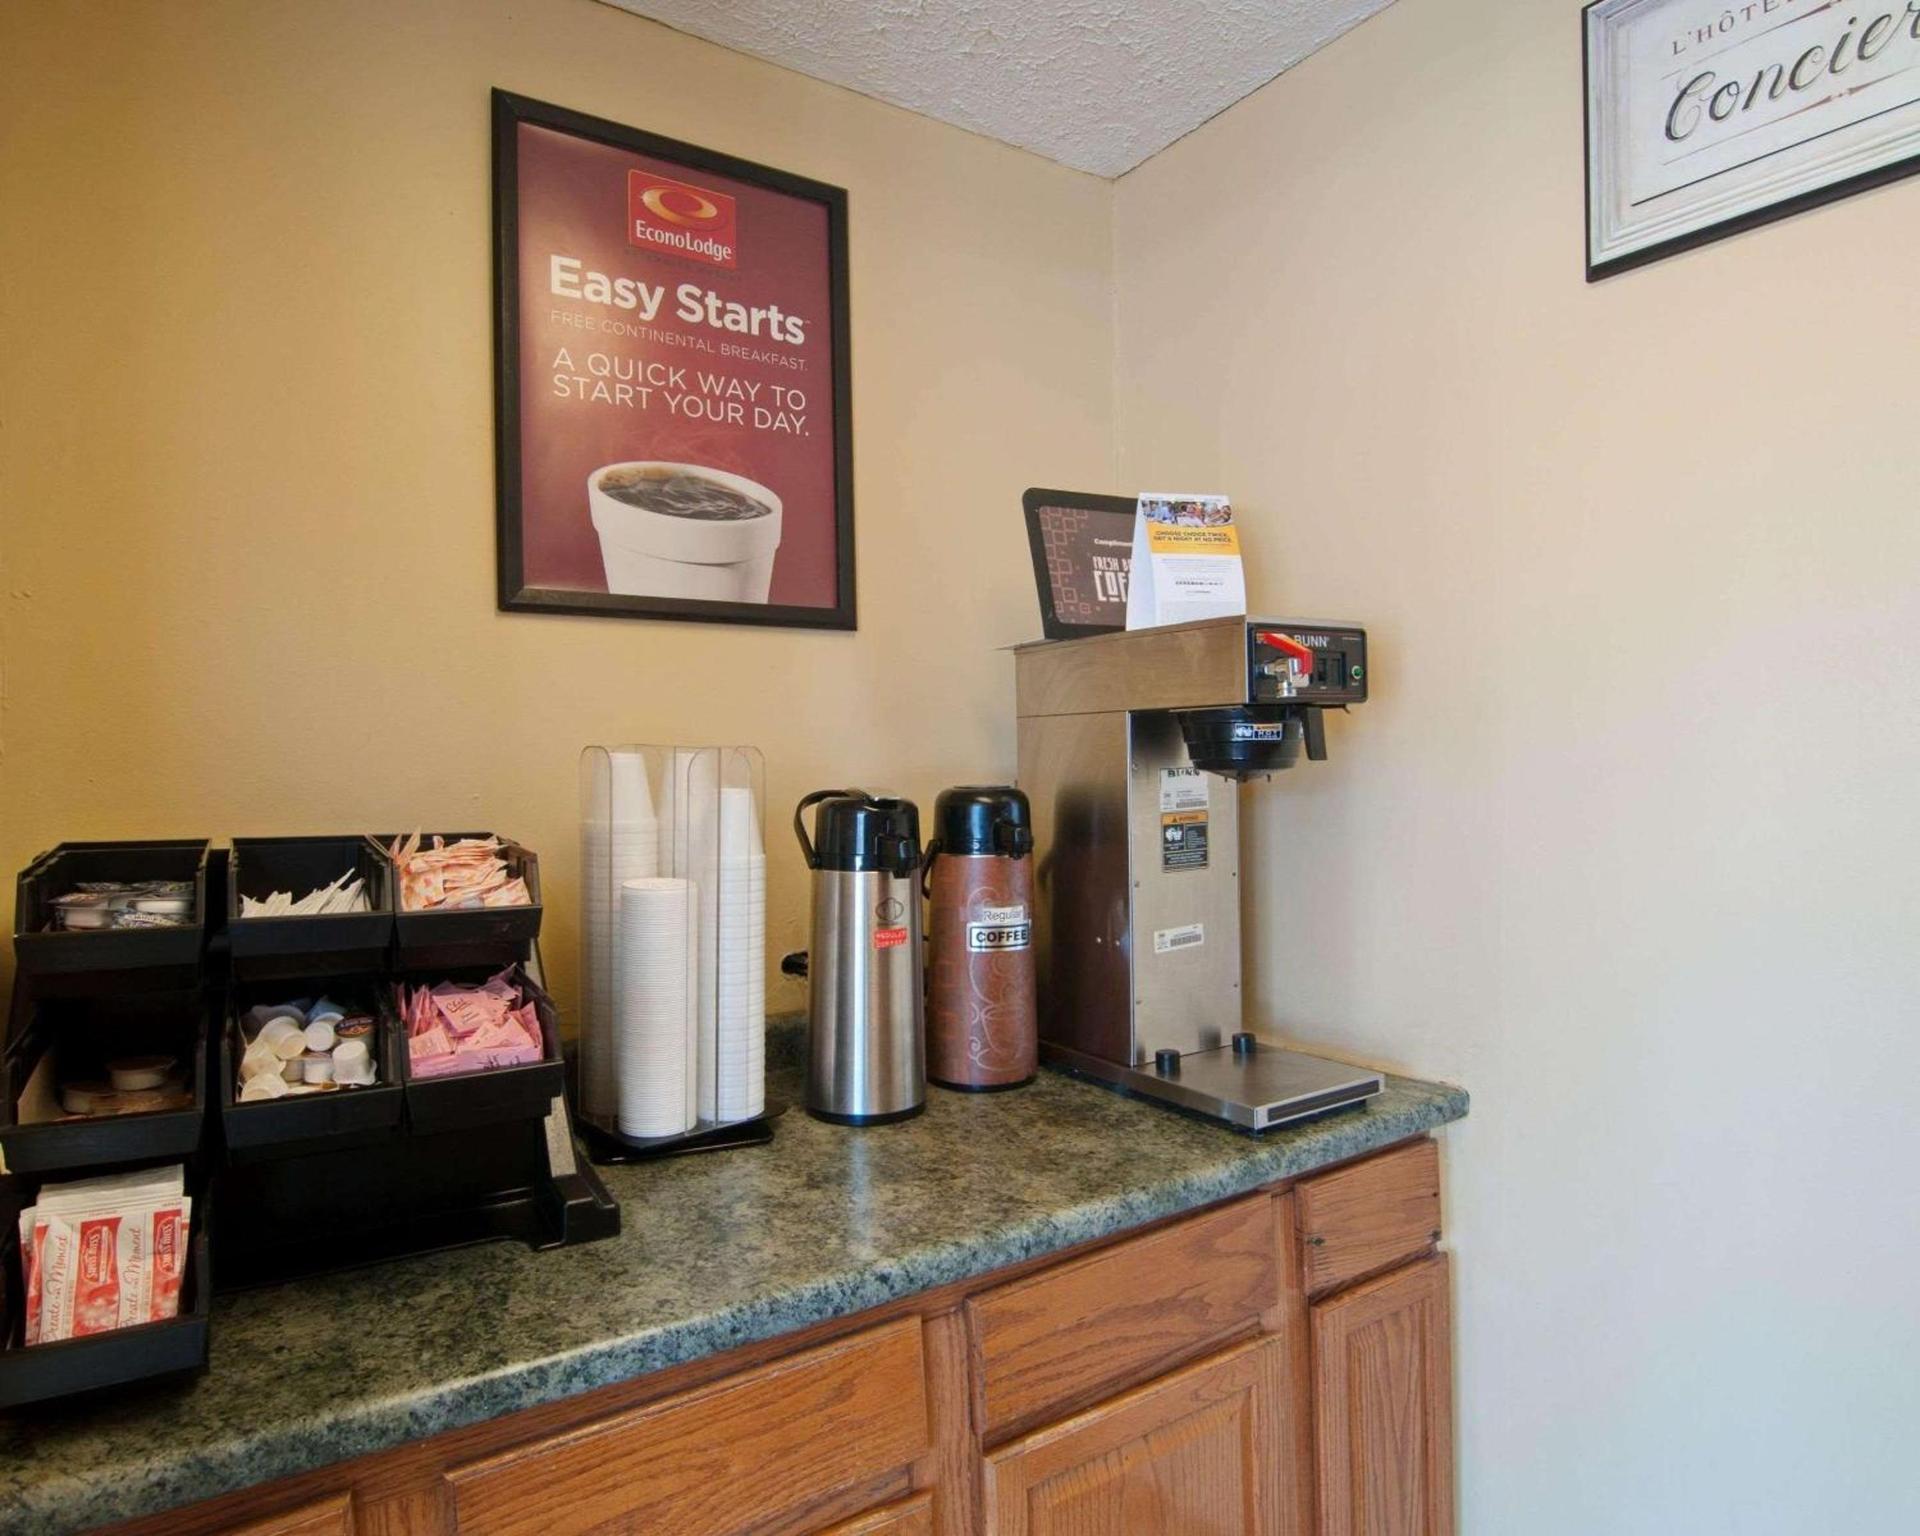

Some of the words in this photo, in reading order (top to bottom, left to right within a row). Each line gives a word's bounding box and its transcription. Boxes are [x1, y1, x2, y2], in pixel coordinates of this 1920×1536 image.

[1672, 0, 1797, 55] L'HÔTE
[635, 219, 732, 261] EconoLodge
[550, 255, 664, 321] Easy
[676, 284, 805, 345] Starts
[551, 310, 596, 330] FREE
[602, 321, 715, 354] CONTINENTAL
[720, 343, 808, 371] BREAKFAST.
[553, 347, 575, 371] A
[587, 353, 687, 390] QUICK
[697, 371, 762, 403] WAY
[771, 386, 806, 411] TO
[553, 374, 653, 410] START
[664, 391, 745, 425] YOUR
[754, 408, 810, 437] DAY.
[1092, 556, 1120, 571] FRESH
[1294, 633, 1328, 648] BUNN
[976, 929, 1028, 943] COFFEE
